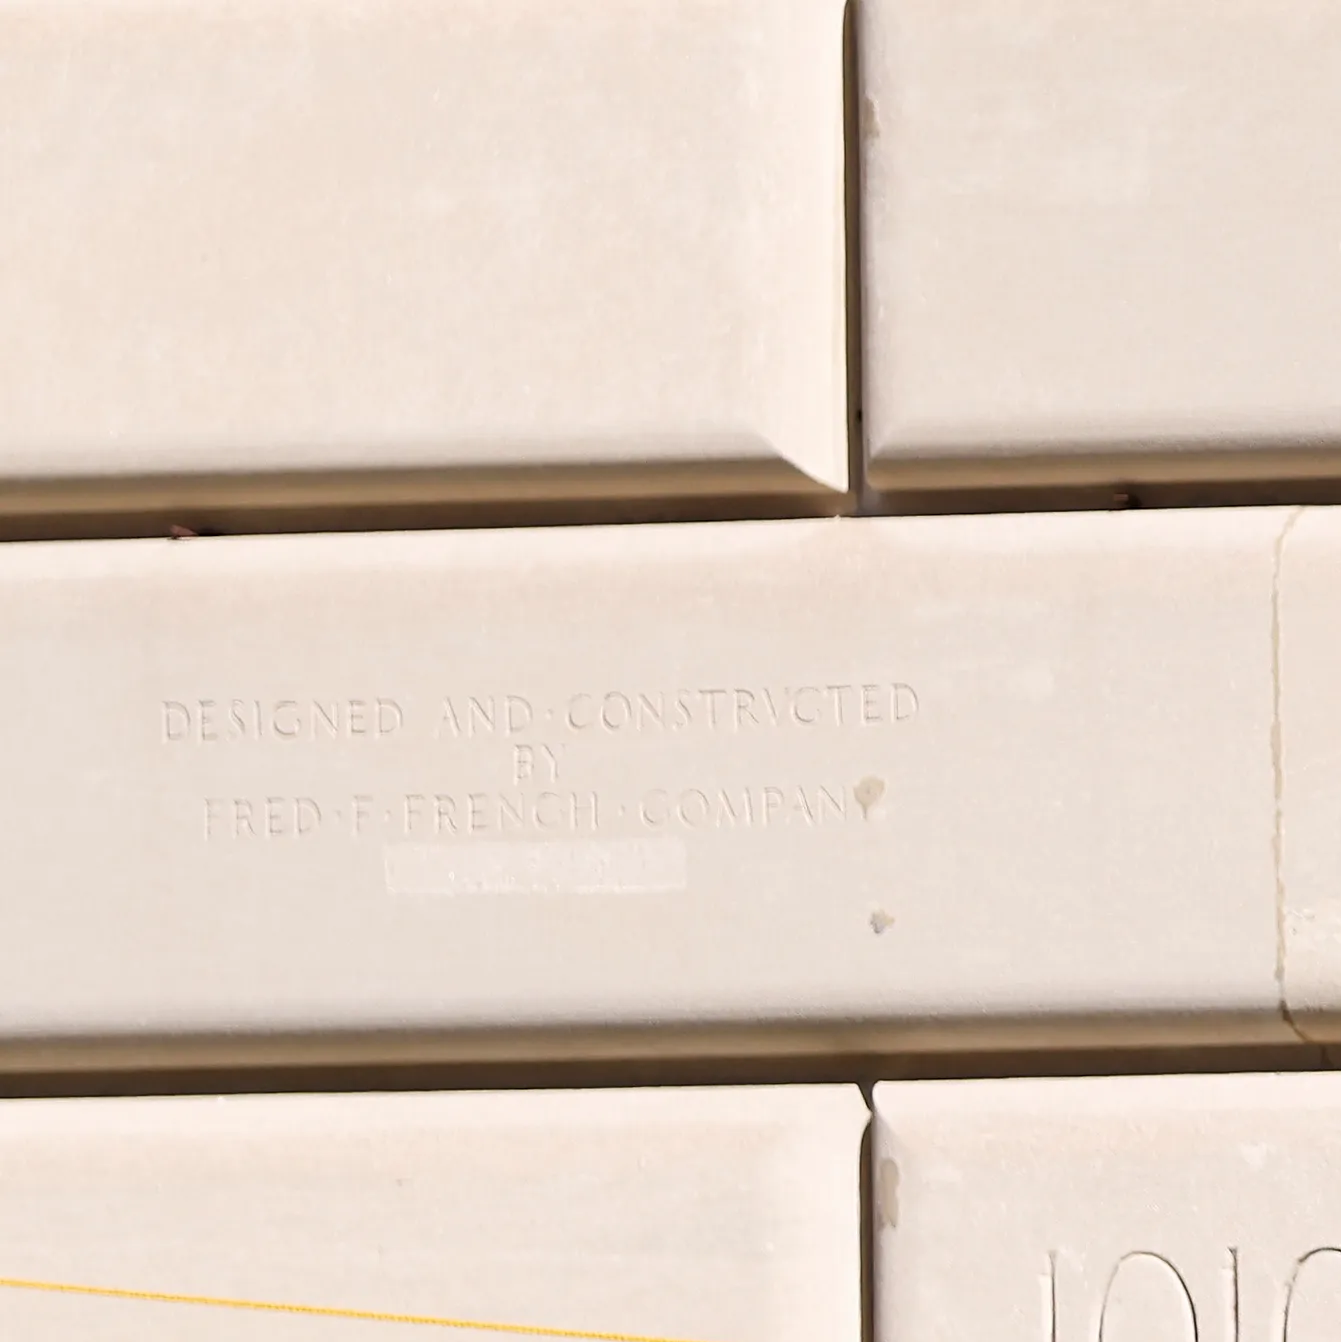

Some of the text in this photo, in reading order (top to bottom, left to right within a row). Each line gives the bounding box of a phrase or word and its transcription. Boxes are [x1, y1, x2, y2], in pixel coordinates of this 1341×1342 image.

[161, 697, 404, 742] DESIGNED
[434, 694, 533, 738] AND
[512, 743, 567, 785] BY
[203, 797, 323, 841] FRED
[404, 789, 601, 835] FRENCH
